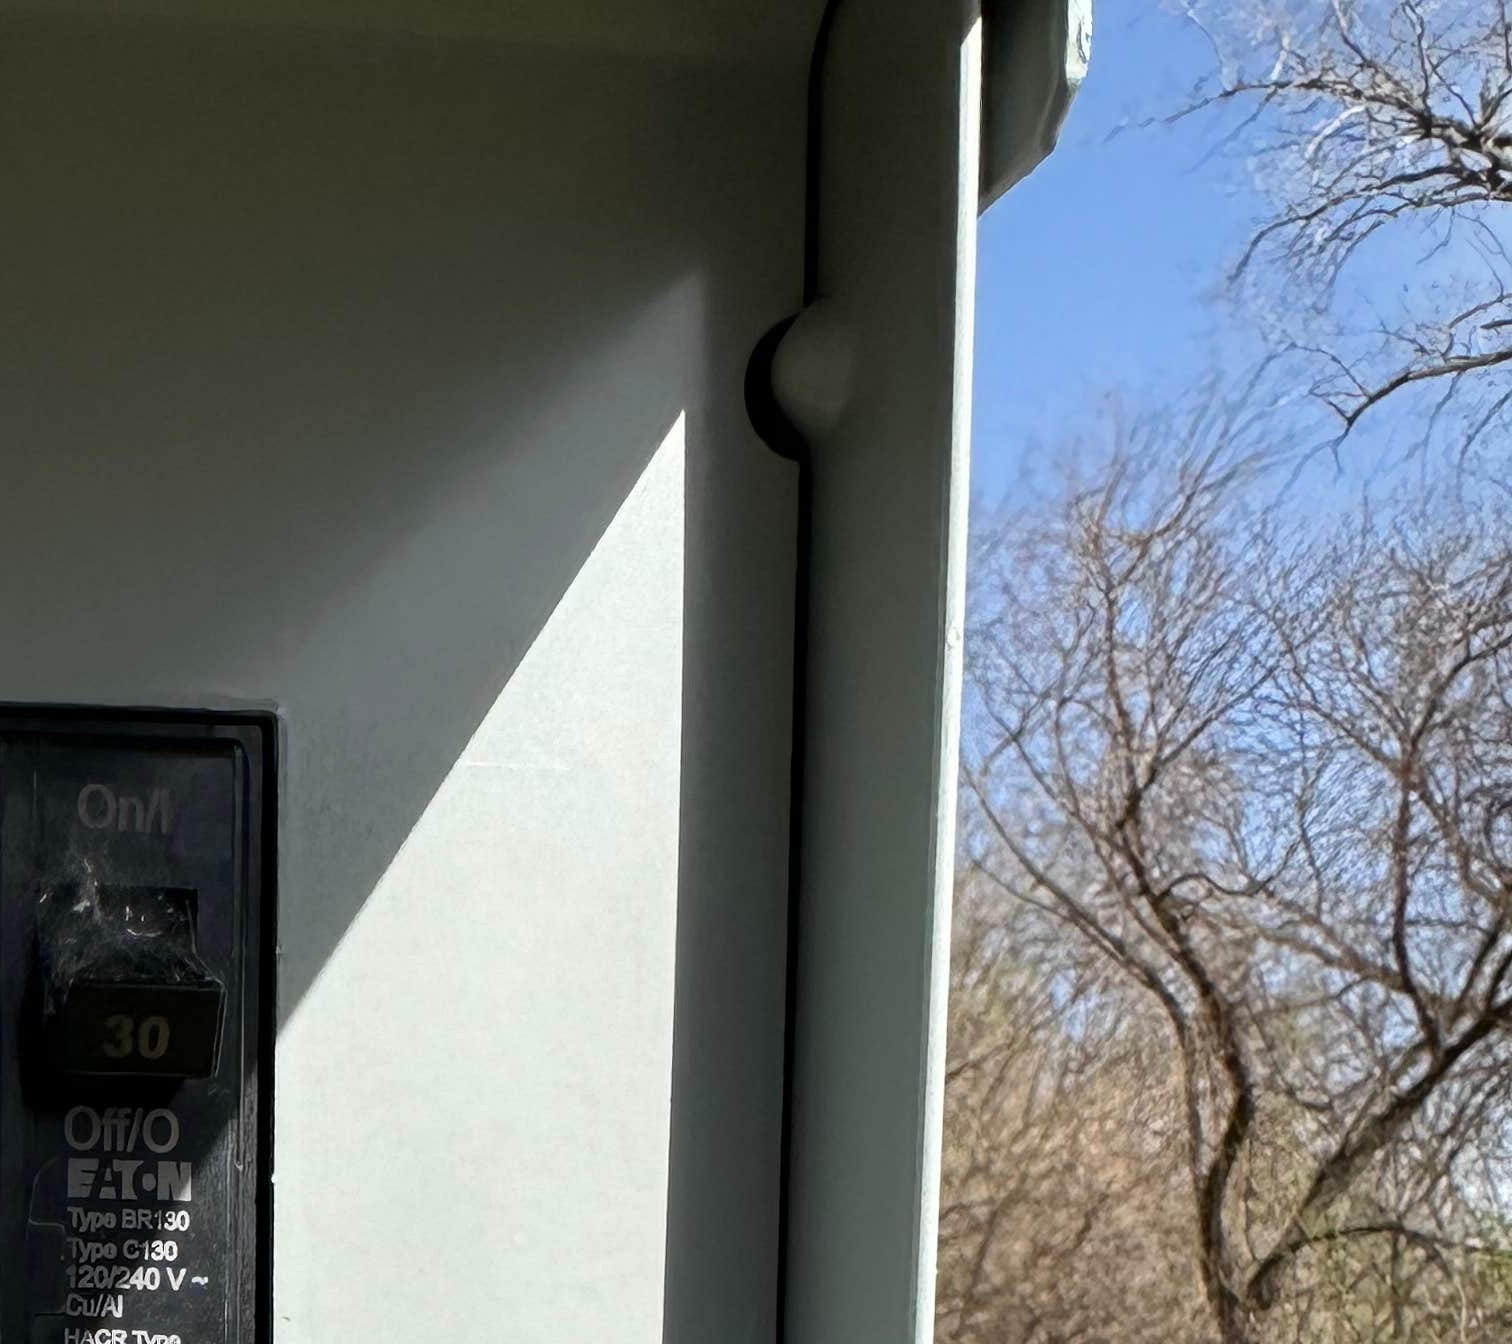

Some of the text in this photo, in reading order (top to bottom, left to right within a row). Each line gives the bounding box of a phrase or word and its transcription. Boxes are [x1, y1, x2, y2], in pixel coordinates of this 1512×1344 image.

[101, 1014, 172, 1060] 30
[63, 1105, 180, 1154] Off/O
[67, 1206, 191, 1233] Type BR130
[67, 1236, 179, 1262] Type C130
[65, 1264, 161, 1291] 120/240
[65, 1293, 124, 1319] Cu/Al
